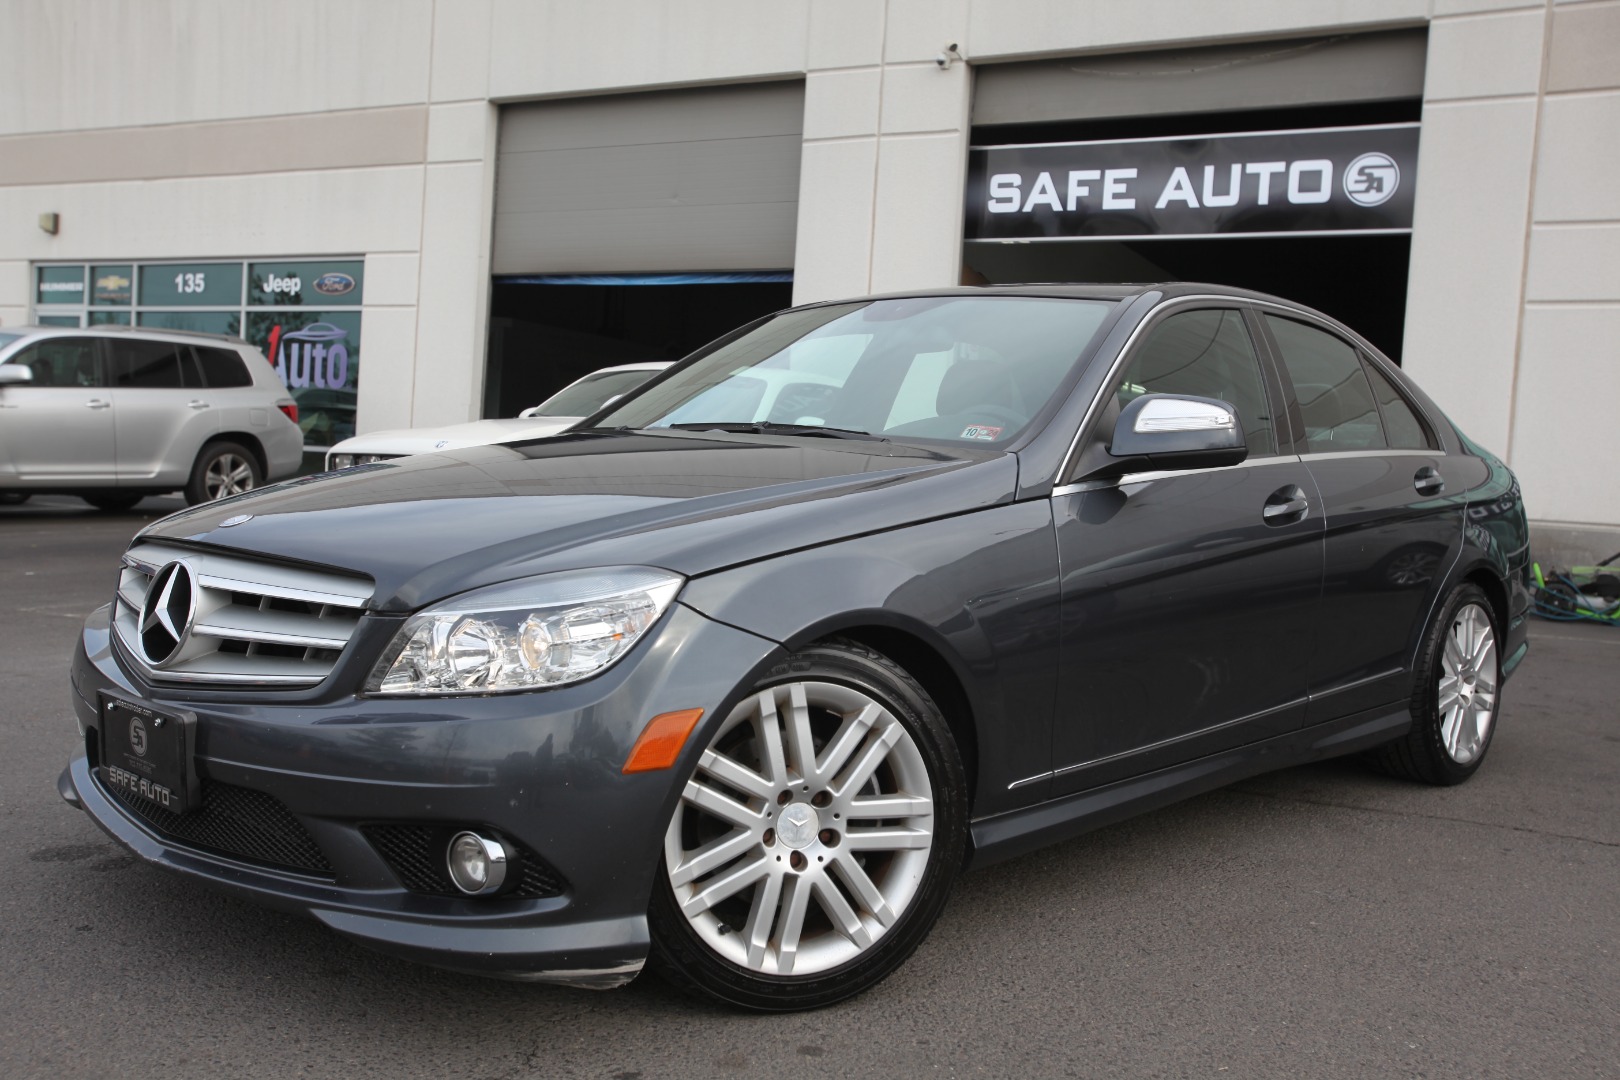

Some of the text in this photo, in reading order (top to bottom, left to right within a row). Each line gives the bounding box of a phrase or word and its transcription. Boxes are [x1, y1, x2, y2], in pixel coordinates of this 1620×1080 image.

[987, 159, 1334, 213] SAFE AUTO
[174, 273, 205, 293] 135
[263, 273, 302, 296] Jeep
[966, 428, 978, 437] 10
[109, 766, 139, 792] SAFE
[140, 779, 171, 806] AUTO
